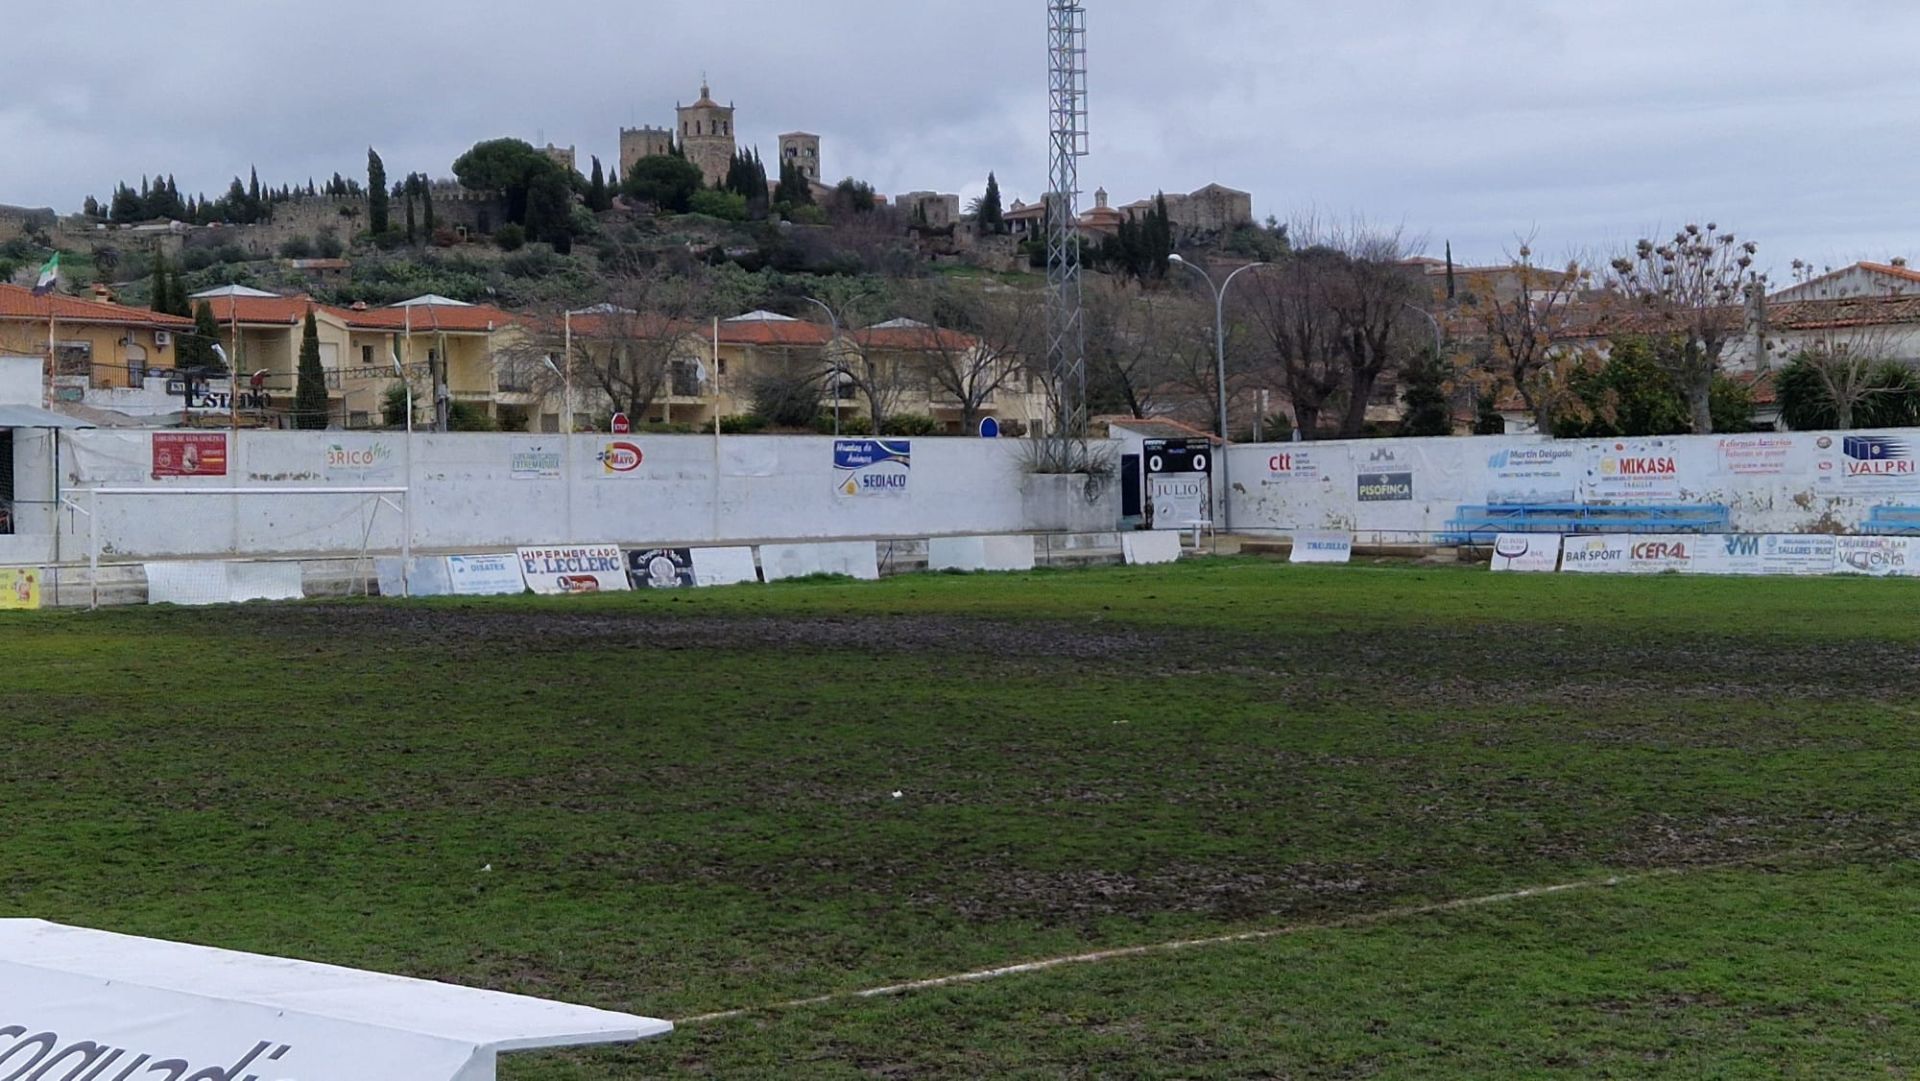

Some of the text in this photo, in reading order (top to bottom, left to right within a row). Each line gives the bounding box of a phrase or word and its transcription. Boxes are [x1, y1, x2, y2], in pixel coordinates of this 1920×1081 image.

[1149, 454, 1206, 472] 0 0
[1269, 453, 1291, 470] ctt
[1620, 457, 1676, 474] MIKASA
[1848, 460, 1915, 474] VALPRI
[1155, 484, 1199, 498] JULIO
[1359, 484, 1409, 496] PISOFINCA
[1307, 542, 1348, 550] TRUJILLO
[521, 548, 617, 559] HIPERMERCADO
[1566, 550, 1622, 561] BAR SPORT
